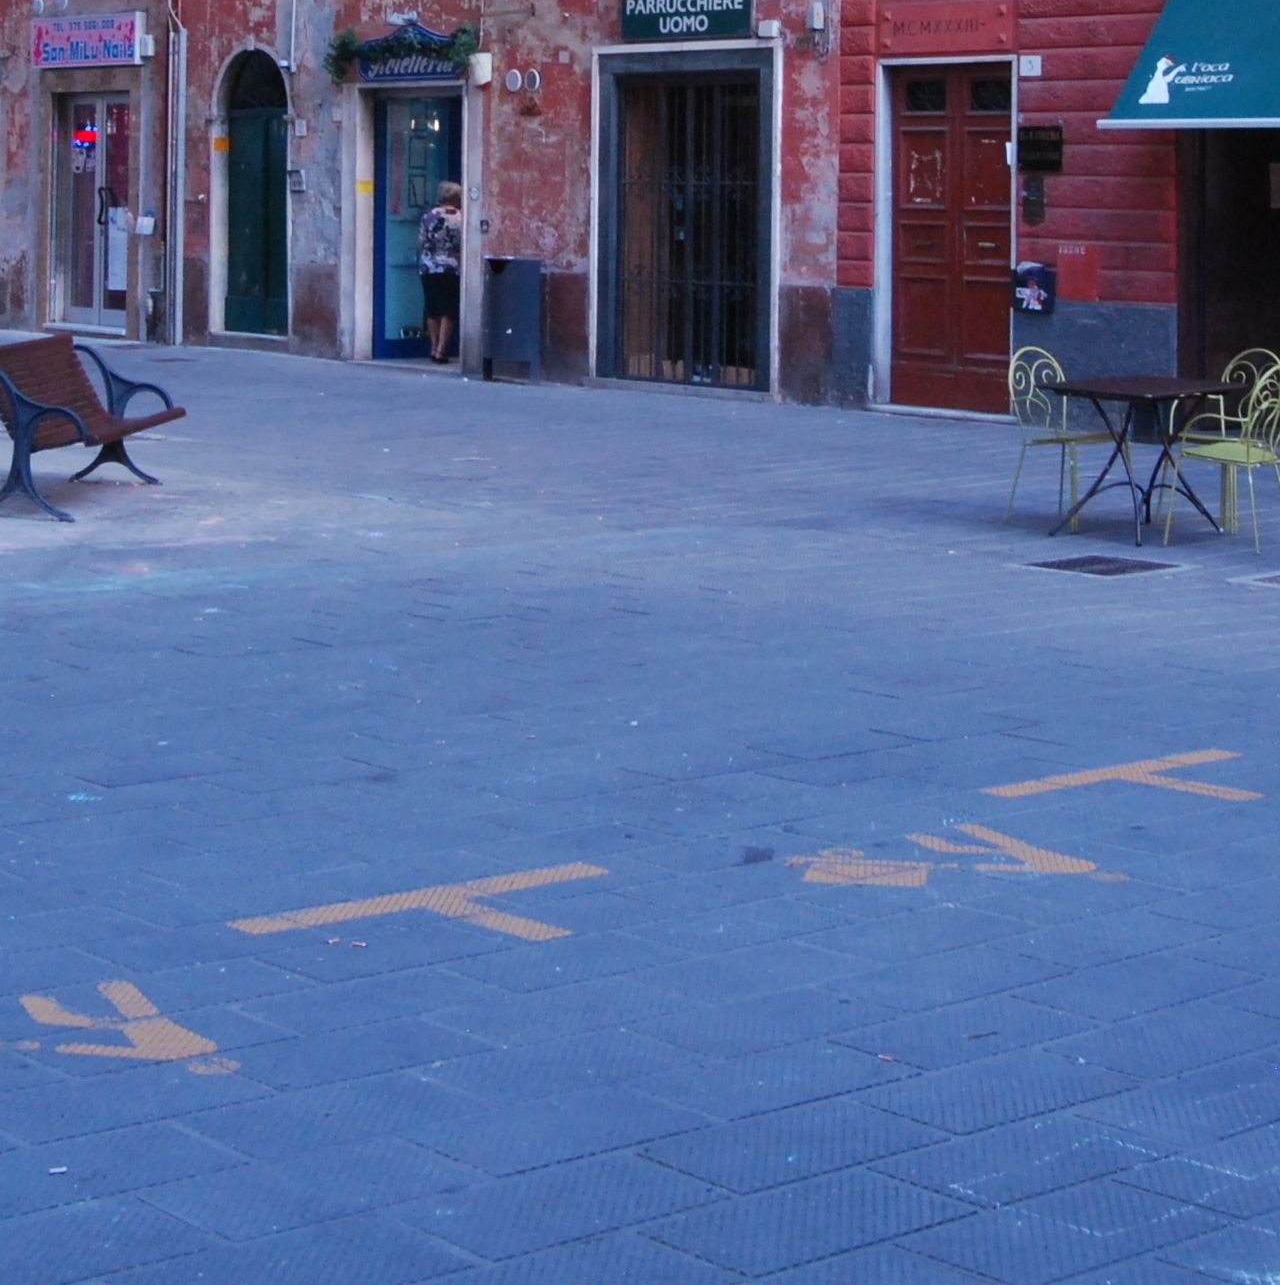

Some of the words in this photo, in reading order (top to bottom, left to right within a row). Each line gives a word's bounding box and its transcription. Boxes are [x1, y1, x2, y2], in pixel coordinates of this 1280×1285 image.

[659, 14, 709, 34] UOMO
[42, 42, 65, 62] San
[103, 39, 135, 59] Nails
